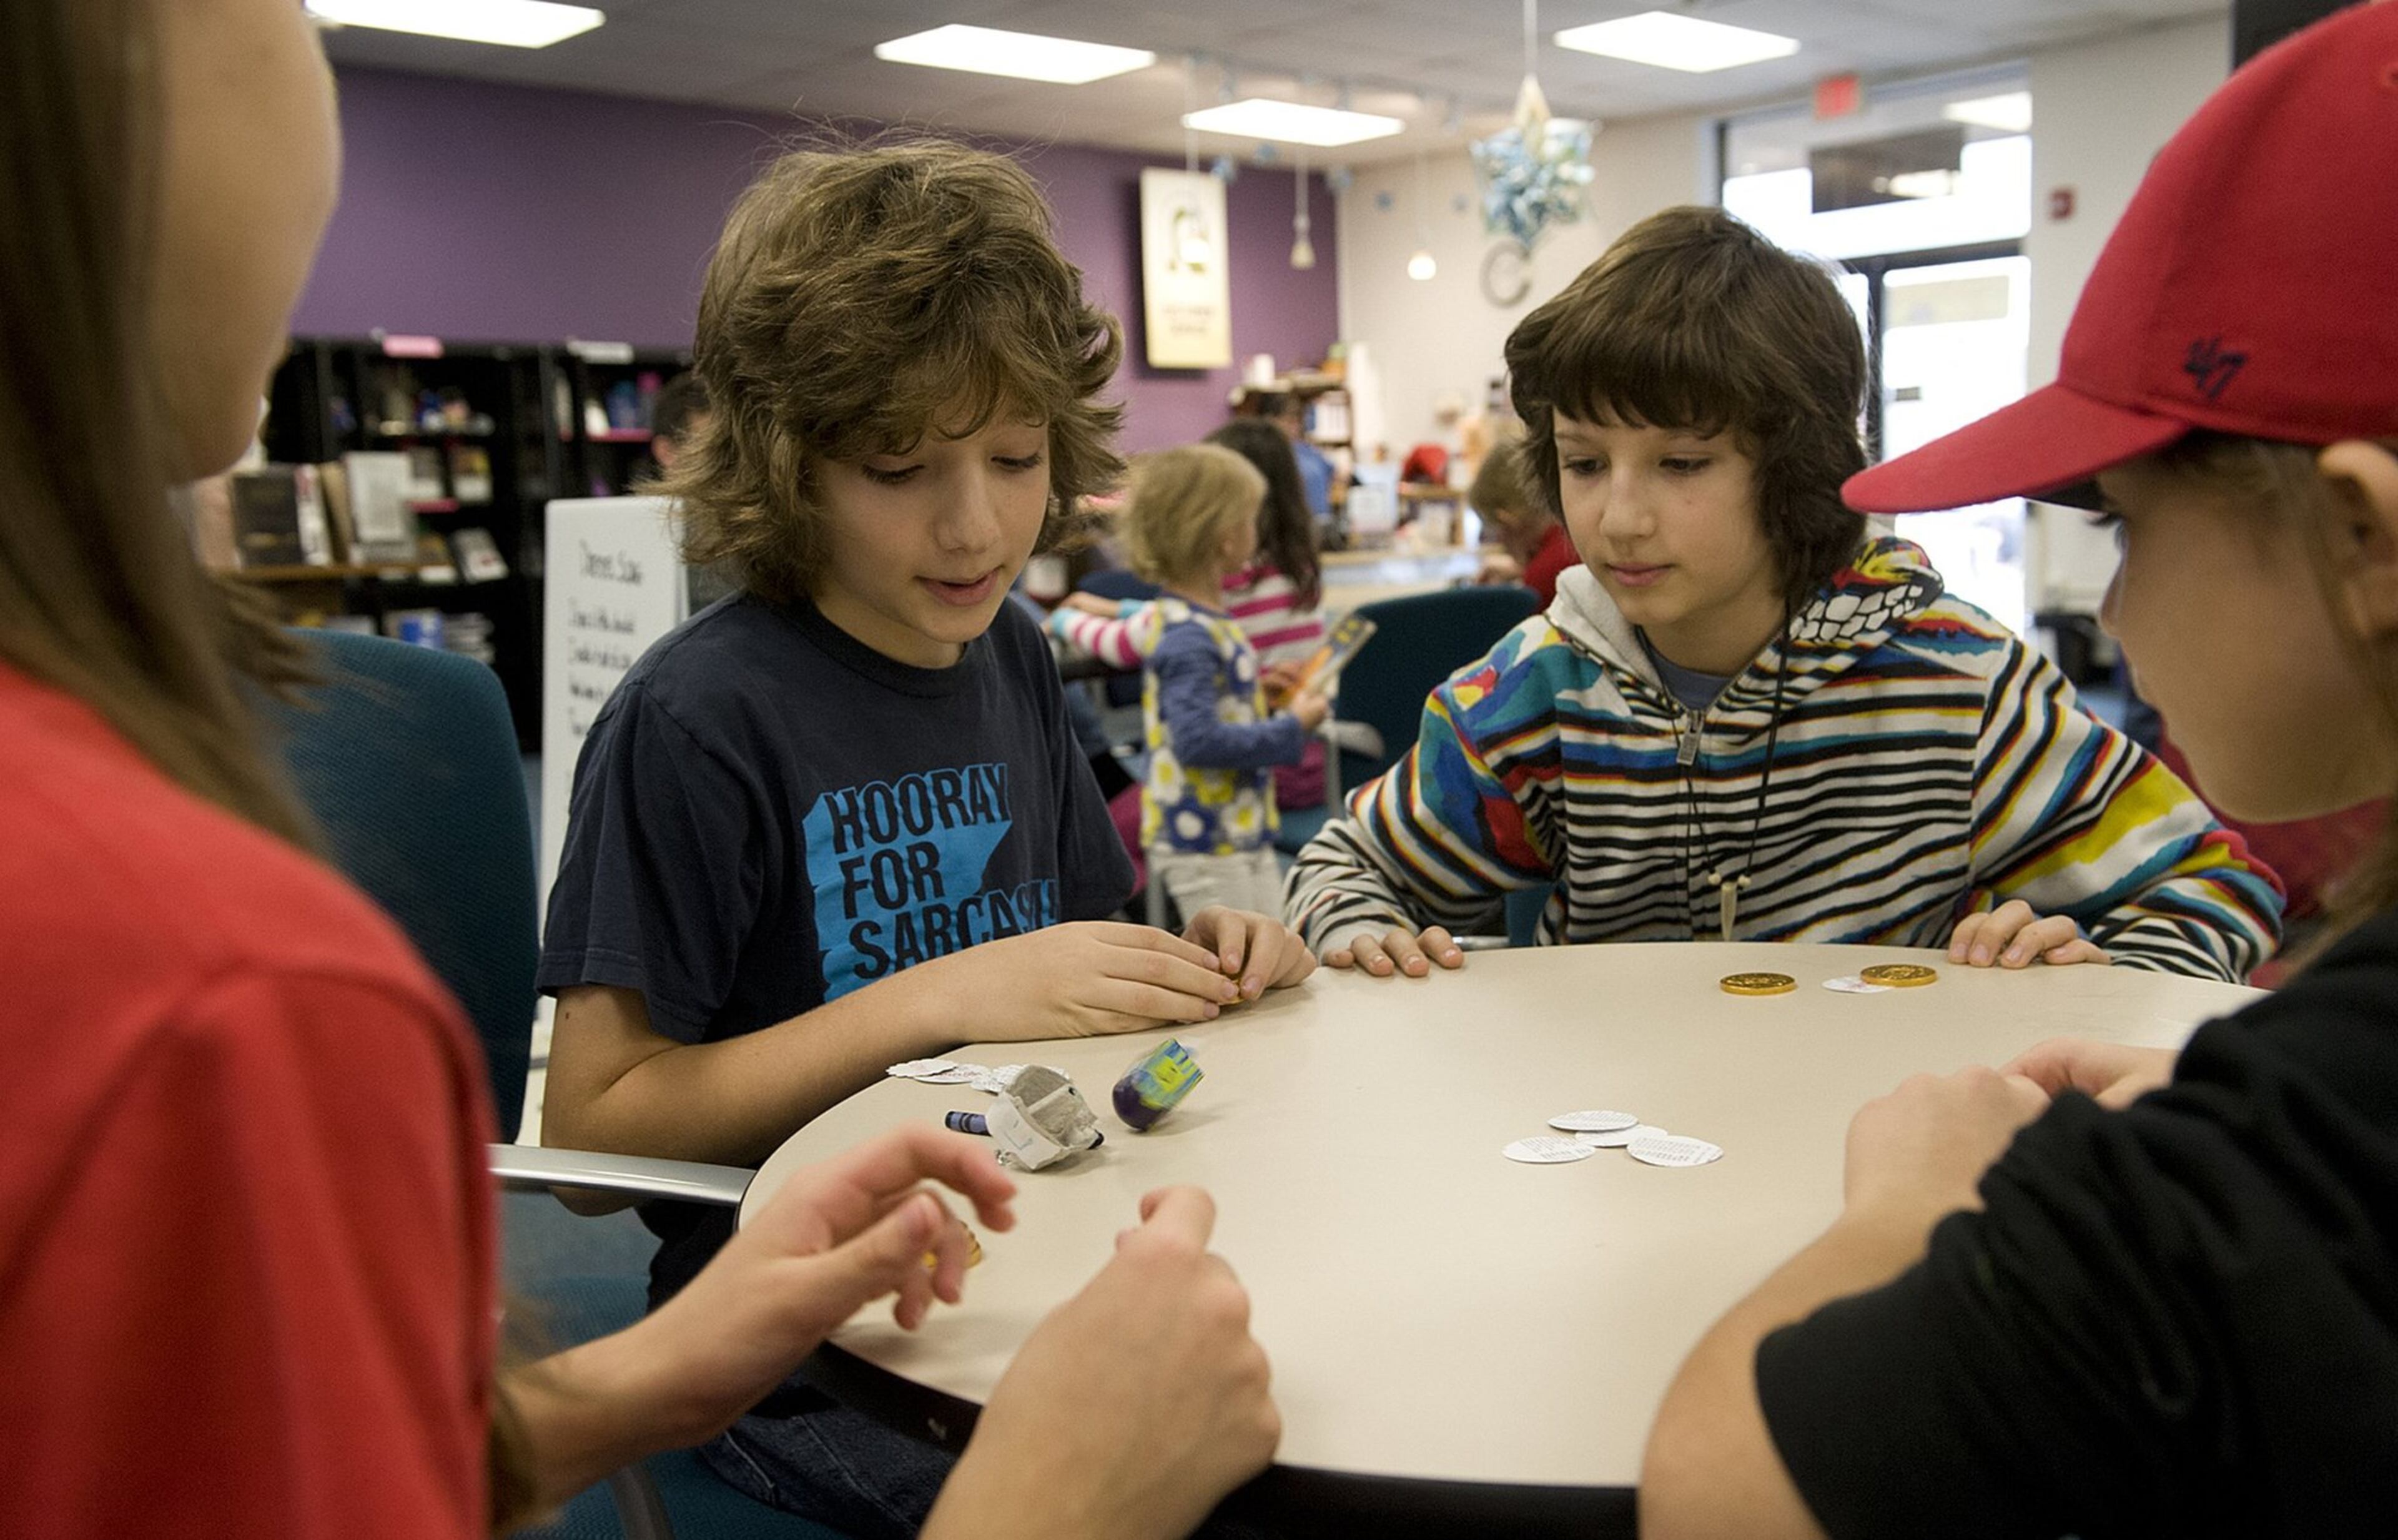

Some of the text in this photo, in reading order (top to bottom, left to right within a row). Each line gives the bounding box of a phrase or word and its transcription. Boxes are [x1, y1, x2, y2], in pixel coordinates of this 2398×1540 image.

[2184, 335, 2246, 400] 47
[824, 763, 1012, 854] HOORAY
[839, 841, 945, 919] FOR
